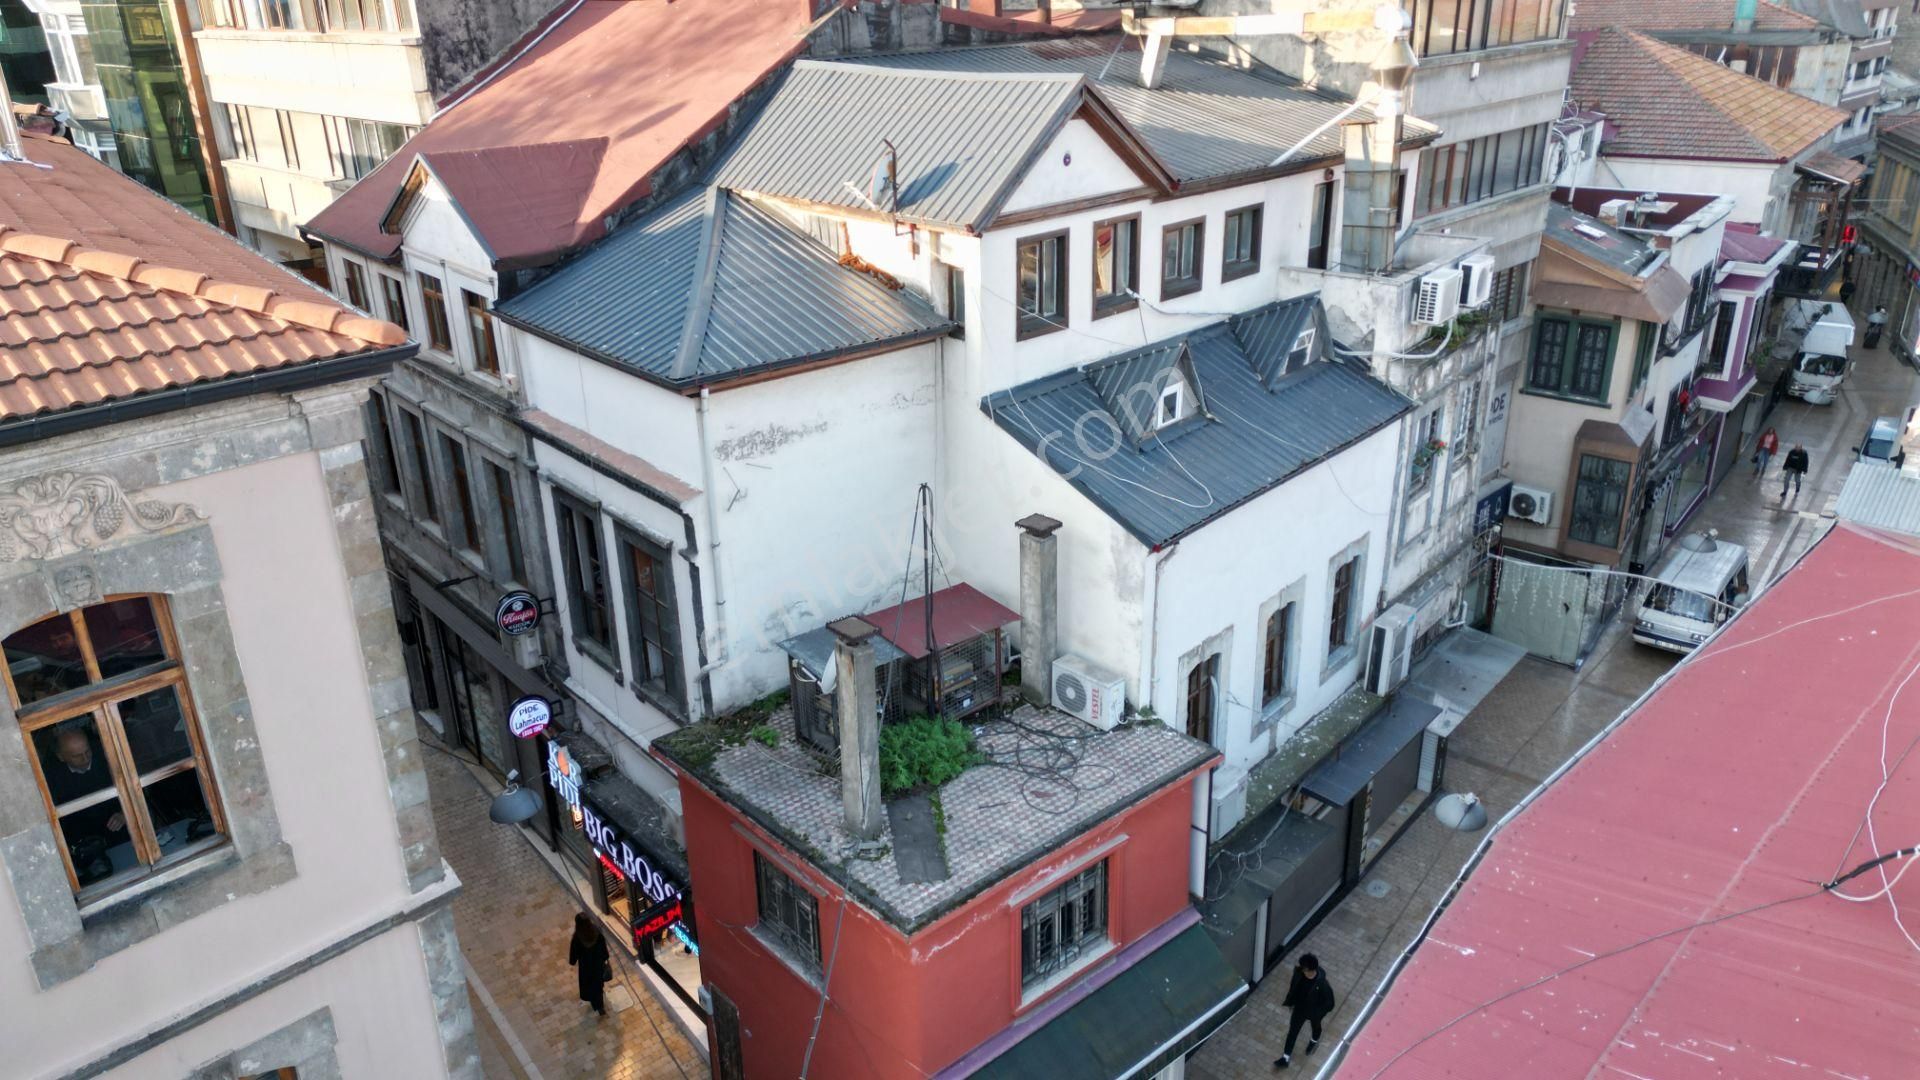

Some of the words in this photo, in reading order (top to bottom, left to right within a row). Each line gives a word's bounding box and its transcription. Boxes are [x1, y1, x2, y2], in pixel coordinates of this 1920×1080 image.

[1091, 687, 1100, 720] VESTEL
[514, 713, 547, 730] Lahmacun
[583, 806, 617, 858] BIG
